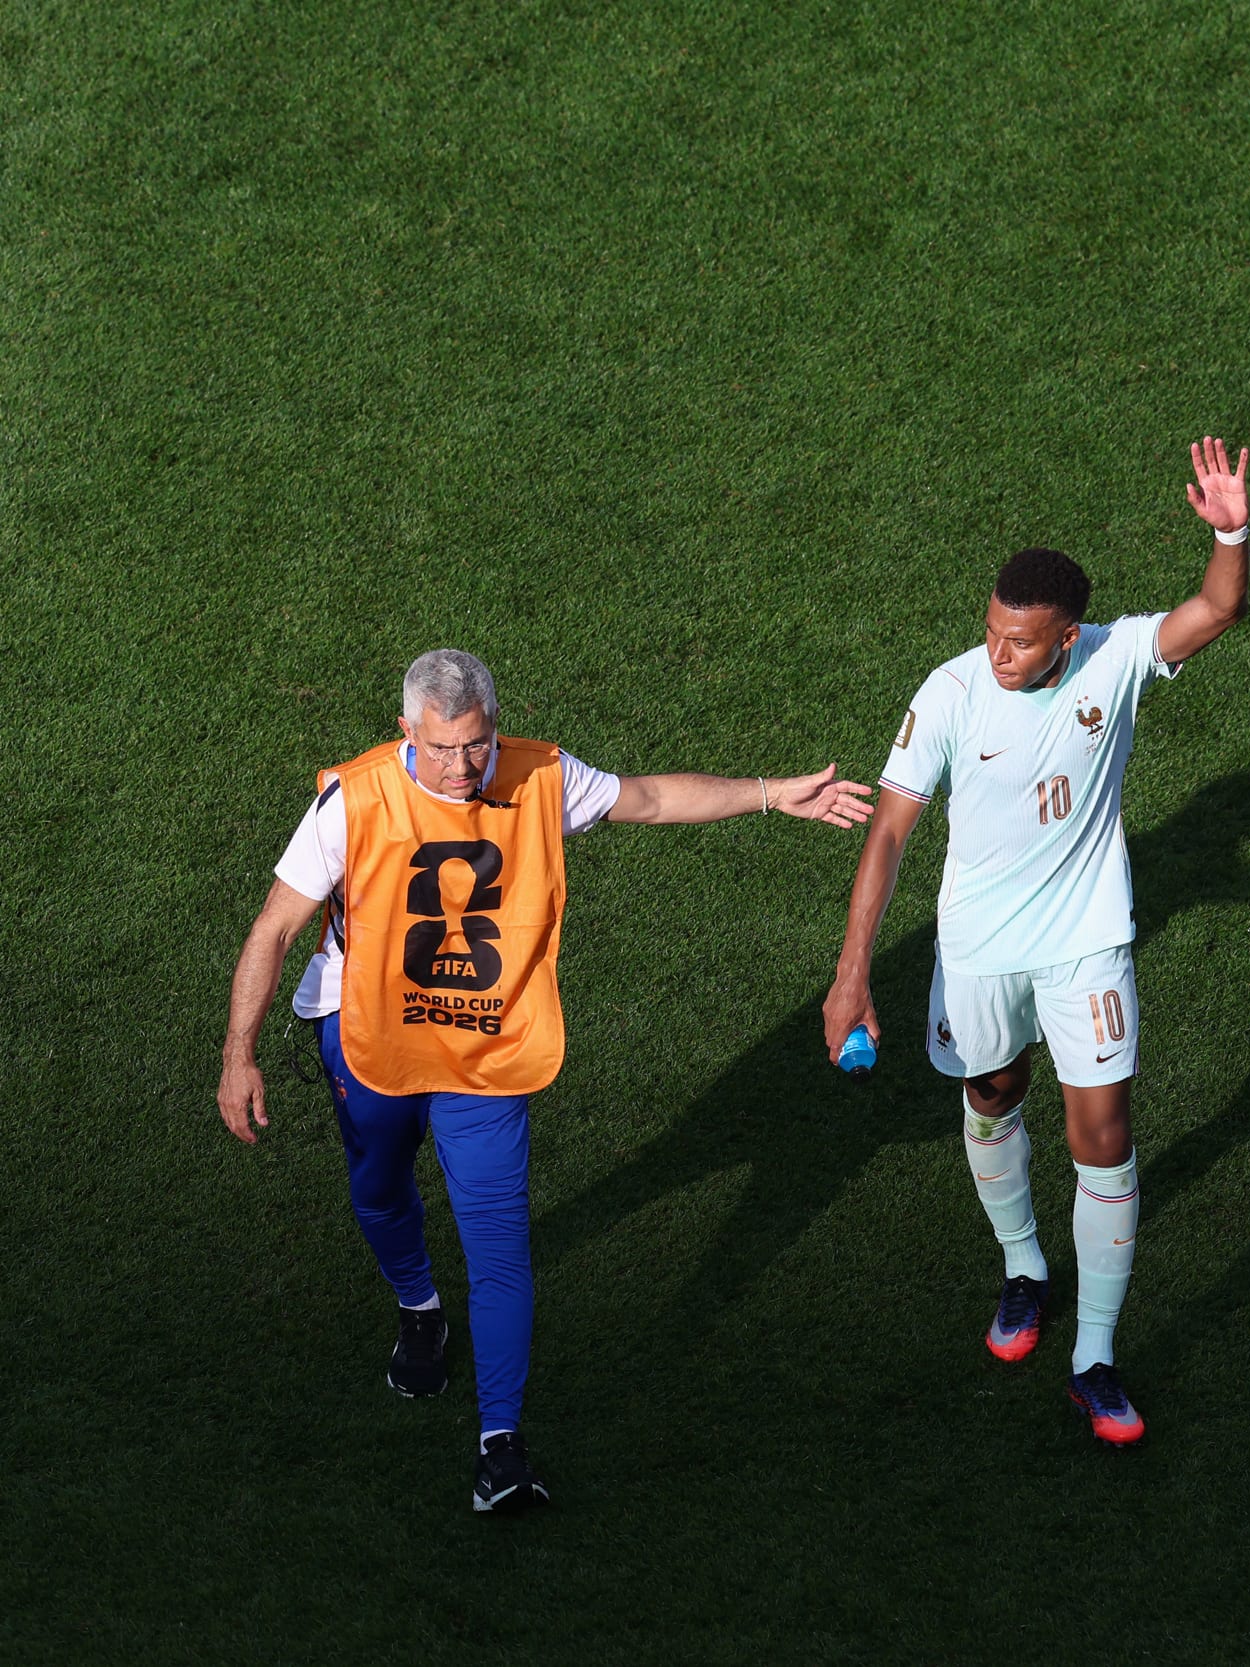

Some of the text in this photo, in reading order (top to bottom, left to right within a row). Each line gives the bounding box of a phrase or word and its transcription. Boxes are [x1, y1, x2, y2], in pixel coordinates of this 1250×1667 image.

[1037, 774, 1072, 825] 10
[431, 959, 478, 978] FIFA
[403, 991, 504, 1012] WORLD CUP
[1088, 989, 1125, 1045] 10
[402, 1005, 503, 1036] 2026
